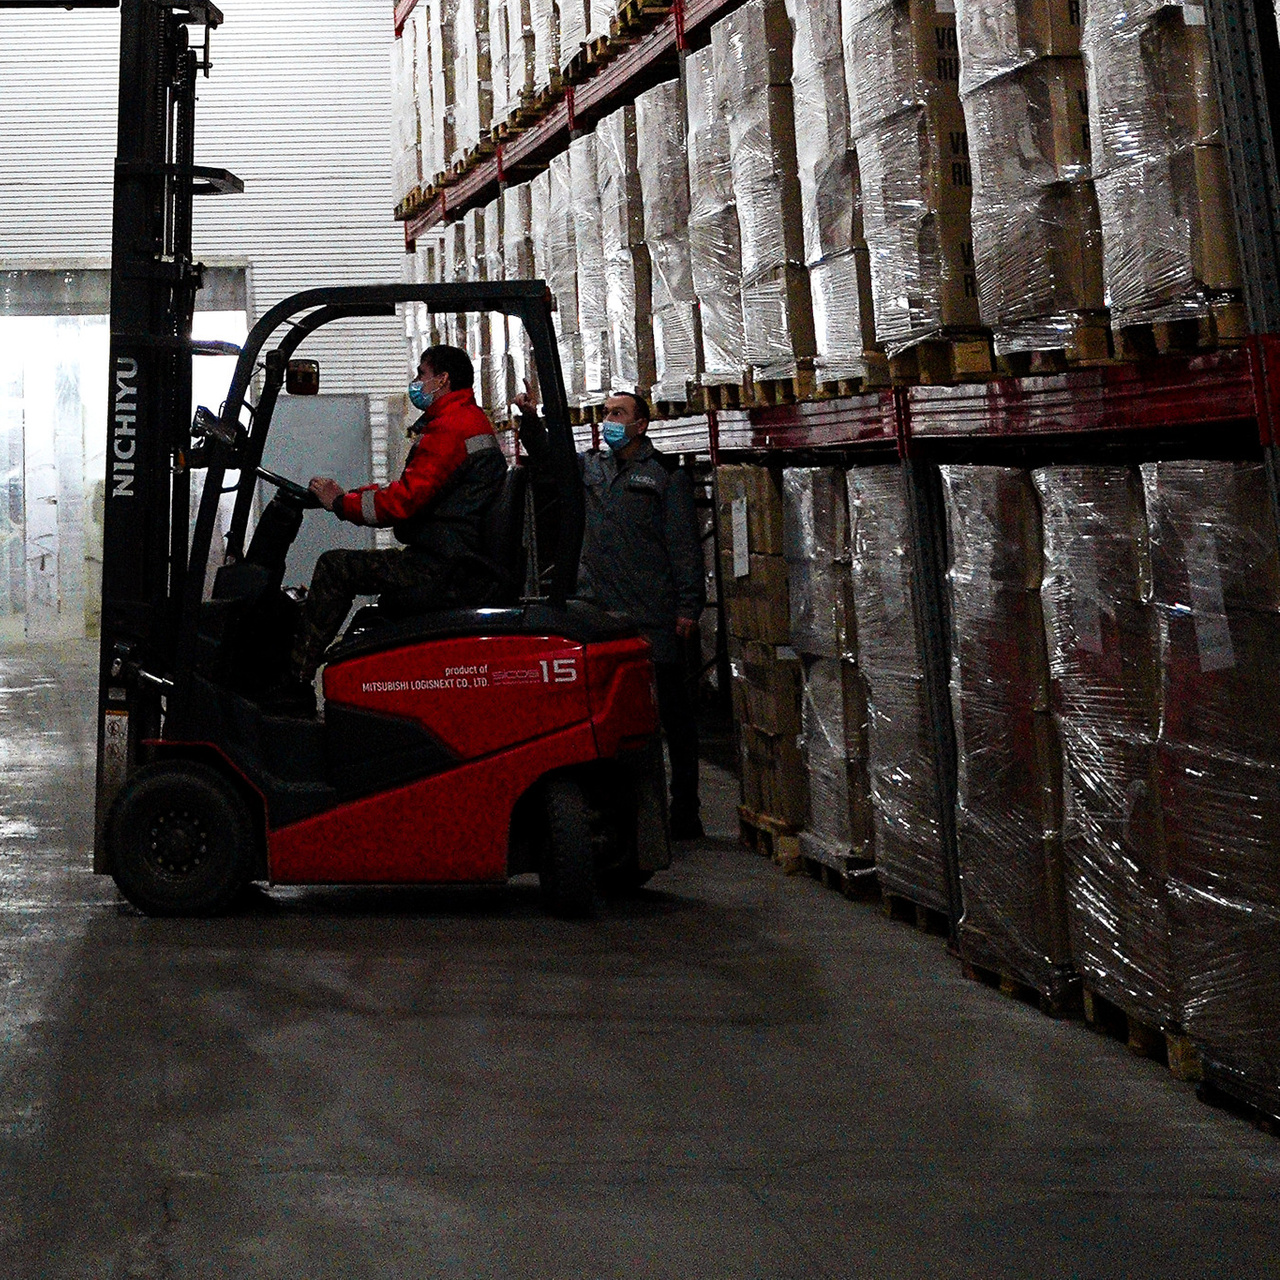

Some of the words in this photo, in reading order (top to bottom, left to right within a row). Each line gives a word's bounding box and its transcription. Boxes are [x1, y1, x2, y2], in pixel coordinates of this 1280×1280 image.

[935, 27, 956, 50] VA
[936, 58, 959, 80] RU
[112, 357, 139, 498] NICHIYU
[445, 665, 478, 676] product
[479, 664, 488, 674] of
[539, 659, 577, 683] 15
[362, 680, 409, 692] MITSUBISHI
[410, 678, 454, 690] LOGISNEXT
[474, 677, 490, 687] LTD.
